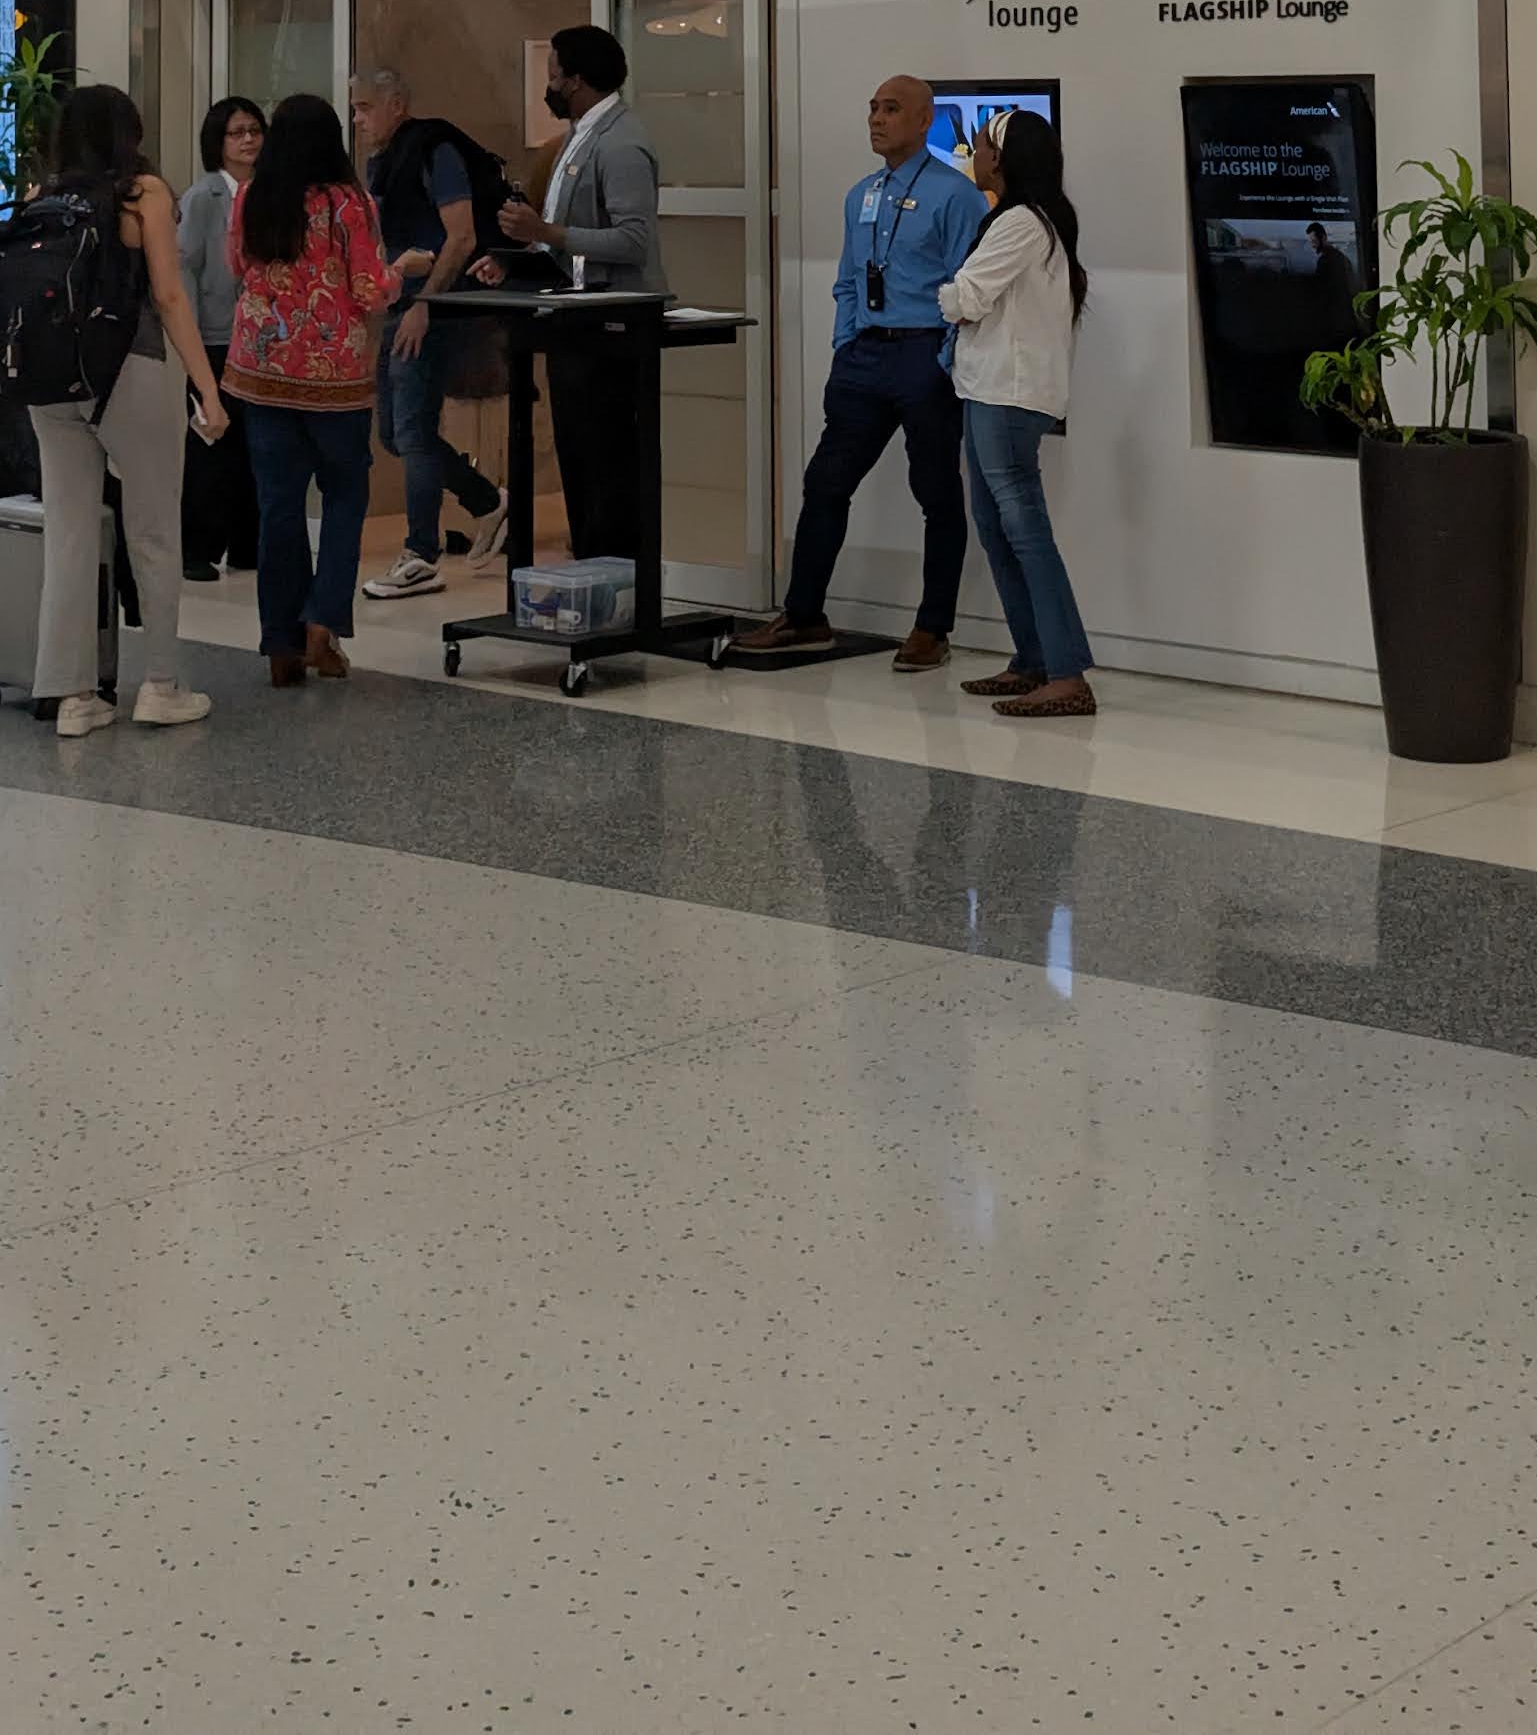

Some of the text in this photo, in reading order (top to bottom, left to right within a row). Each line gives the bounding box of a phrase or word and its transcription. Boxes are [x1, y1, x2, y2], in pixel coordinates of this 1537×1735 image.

[988, 0, 1079, 34] lounge
[1157, 0, 1269, 23] FLAGSHIP
[1289, 106, 1328, 116] American
[1199, 142, 1303, 158] Welcome to the
[1200, 160, 1330, 181] FLAGSHIP Lounge
